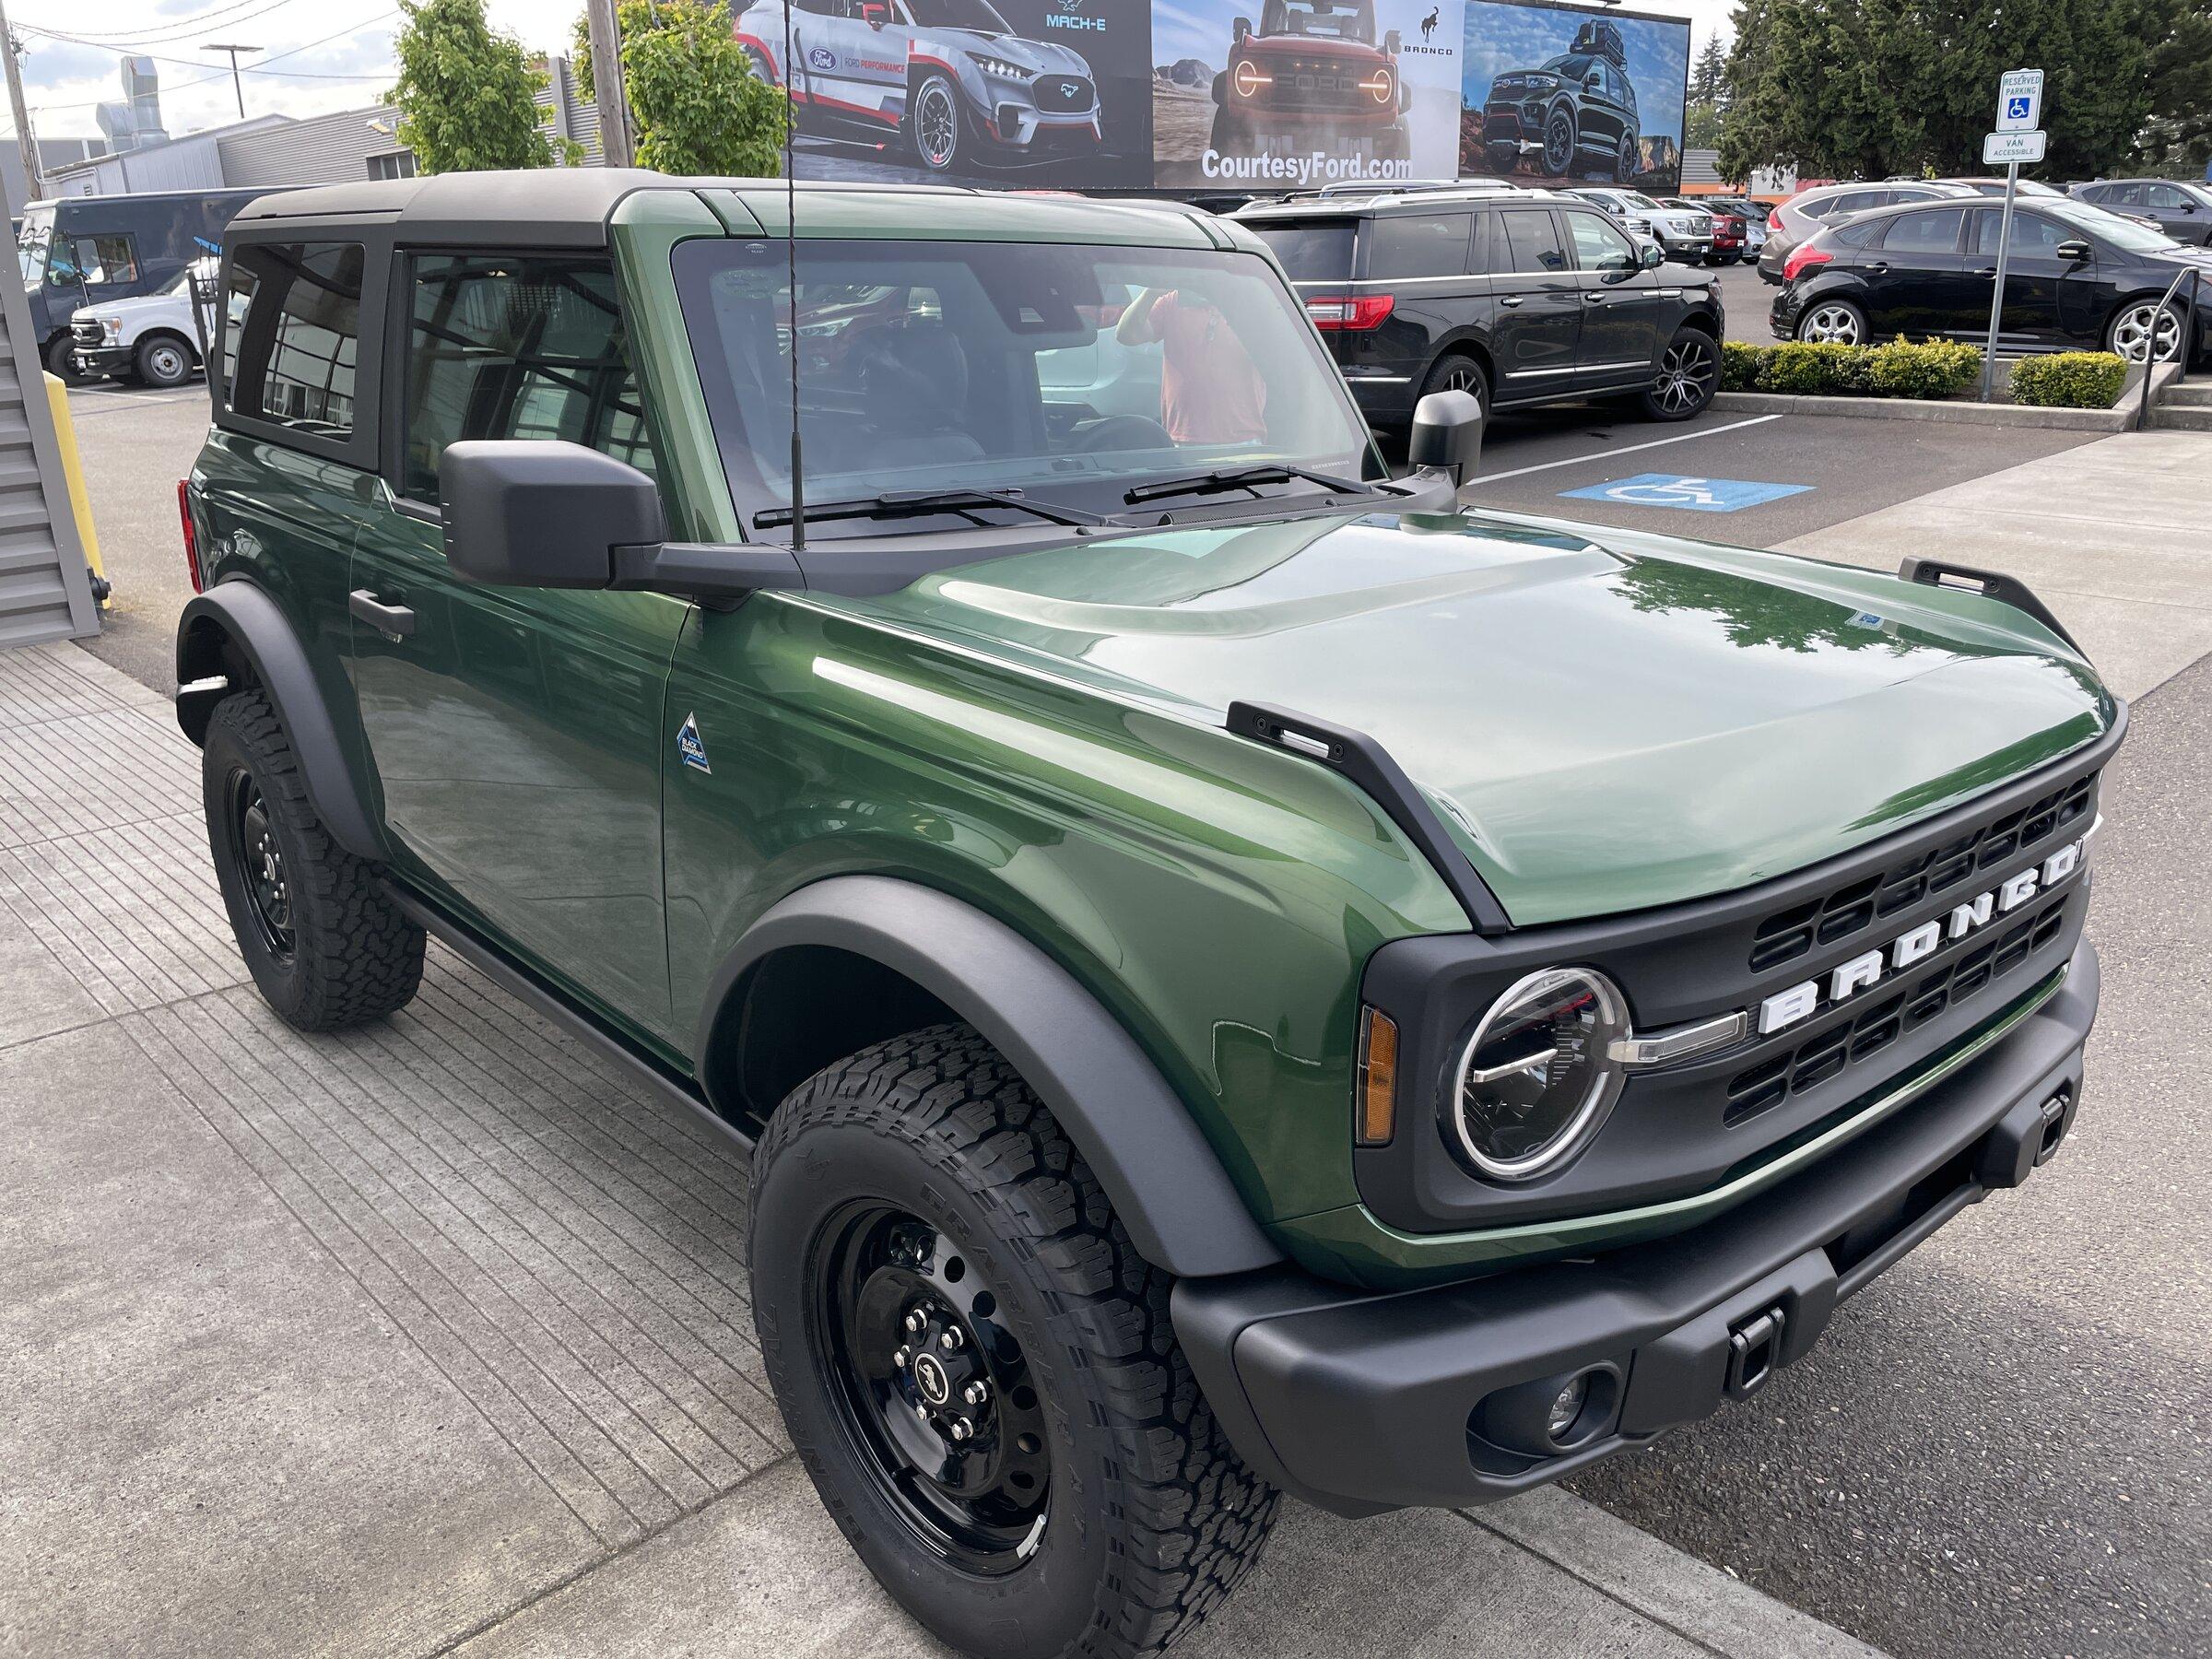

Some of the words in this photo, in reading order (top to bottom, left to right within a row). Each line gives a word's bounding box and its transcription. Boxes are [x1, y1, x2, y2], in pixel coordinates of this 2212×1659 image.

[1046, 14, 1106, 30] MACH-E
[1404, 45, 1453, 55] BRONCO
[814, 49, 832, 68] Ford
[844, 56, 860, 68] FORD
[860, 59, 906, 74] PERFORMANCE
[2004, 76, 2040, 86] RESERVED
[2006, 86, 2037, 96] PARKING
[2006, 139, 2024, 147] VAN
[1994, 147, 2034, 157] ACCESSIBLE
[1202, 148, 1414, 184] CourtesyFord.com
[1758, 843, 2077, 1034] BRONCO
[919, 1180, 1077, 1448] GRABBER
